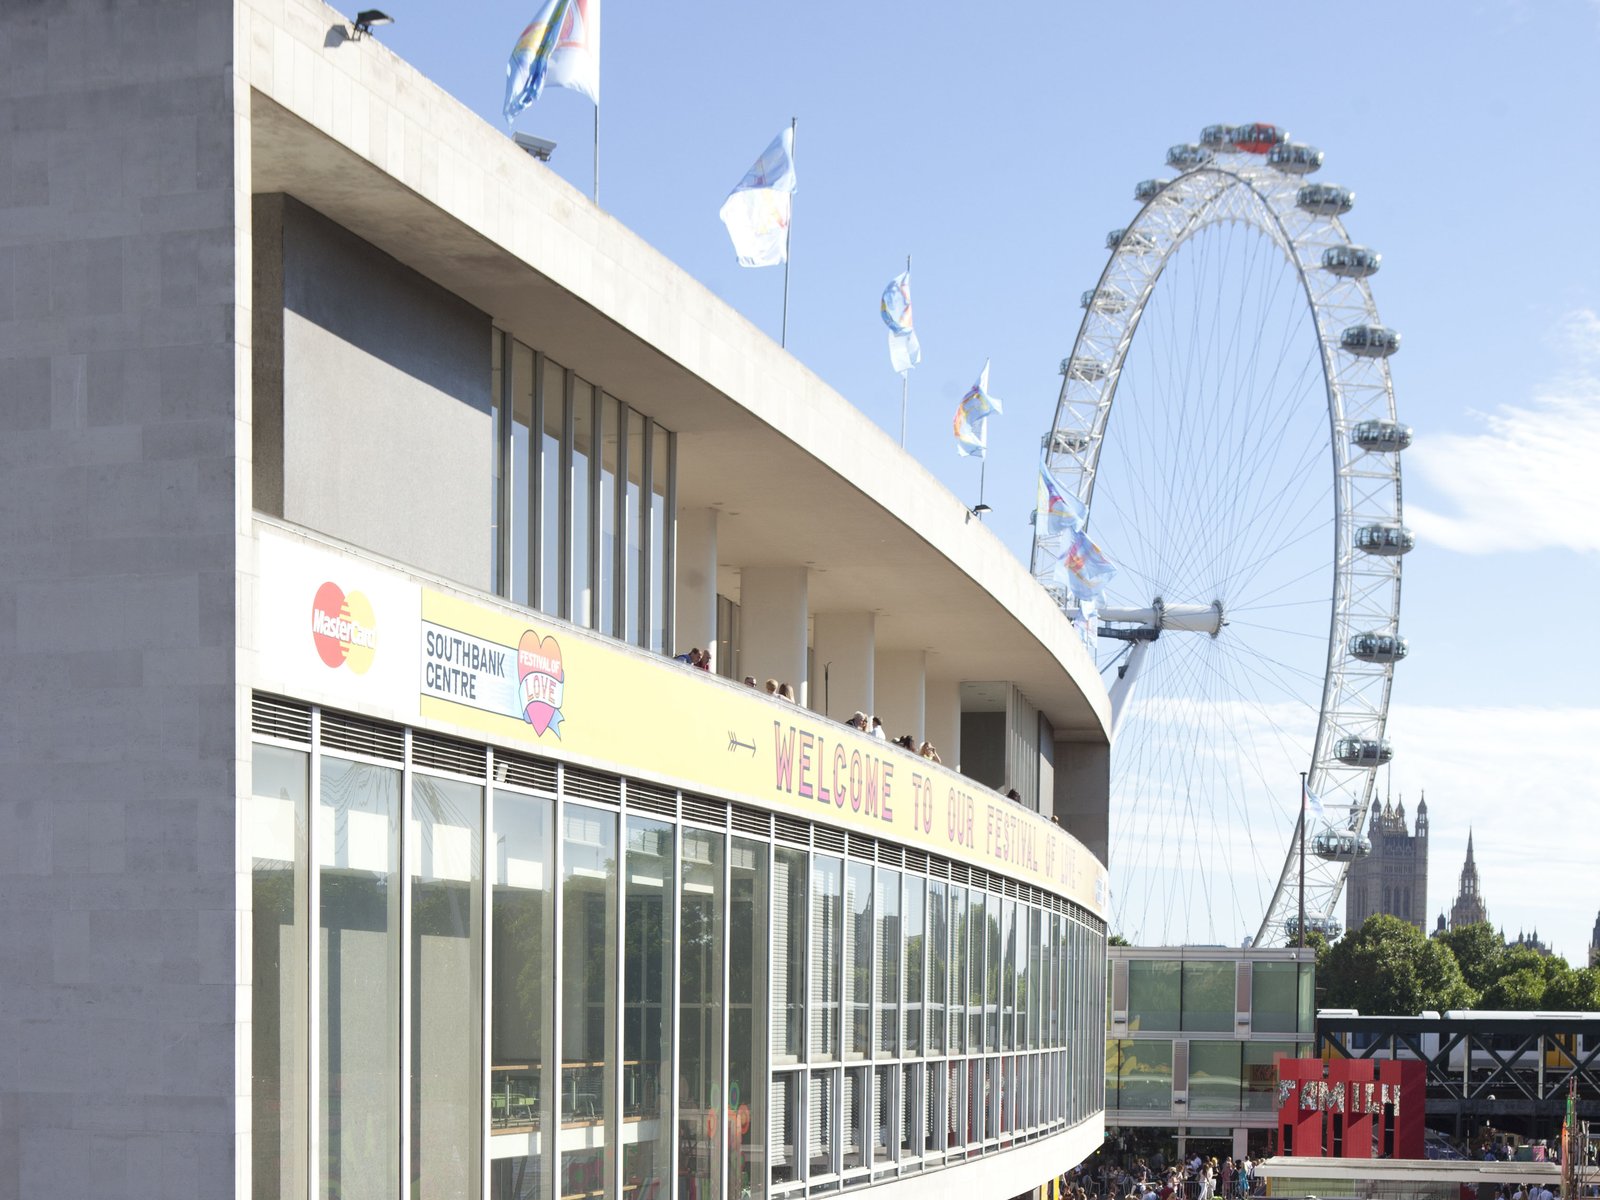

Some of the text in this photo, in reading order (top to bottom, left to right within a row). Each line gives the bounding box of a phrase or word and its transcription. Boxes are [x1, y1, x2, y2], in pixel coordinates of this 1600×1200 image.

[314, 608, 375, 649] MasterCard
[426, 630, 506, 678] SOUTHBANK
[519, 649, 561, 674] FESTIVAL OF
[426, 661, 477, 700] CENTRE
[525, 674, 557, 704] LOVE
[774, 720, 894, 823] WELCOME
[912, 772, 932, 835] TO
[947, 786, 975, 849] OUR
[986, 804, 1038, 873] FESTIVAL
